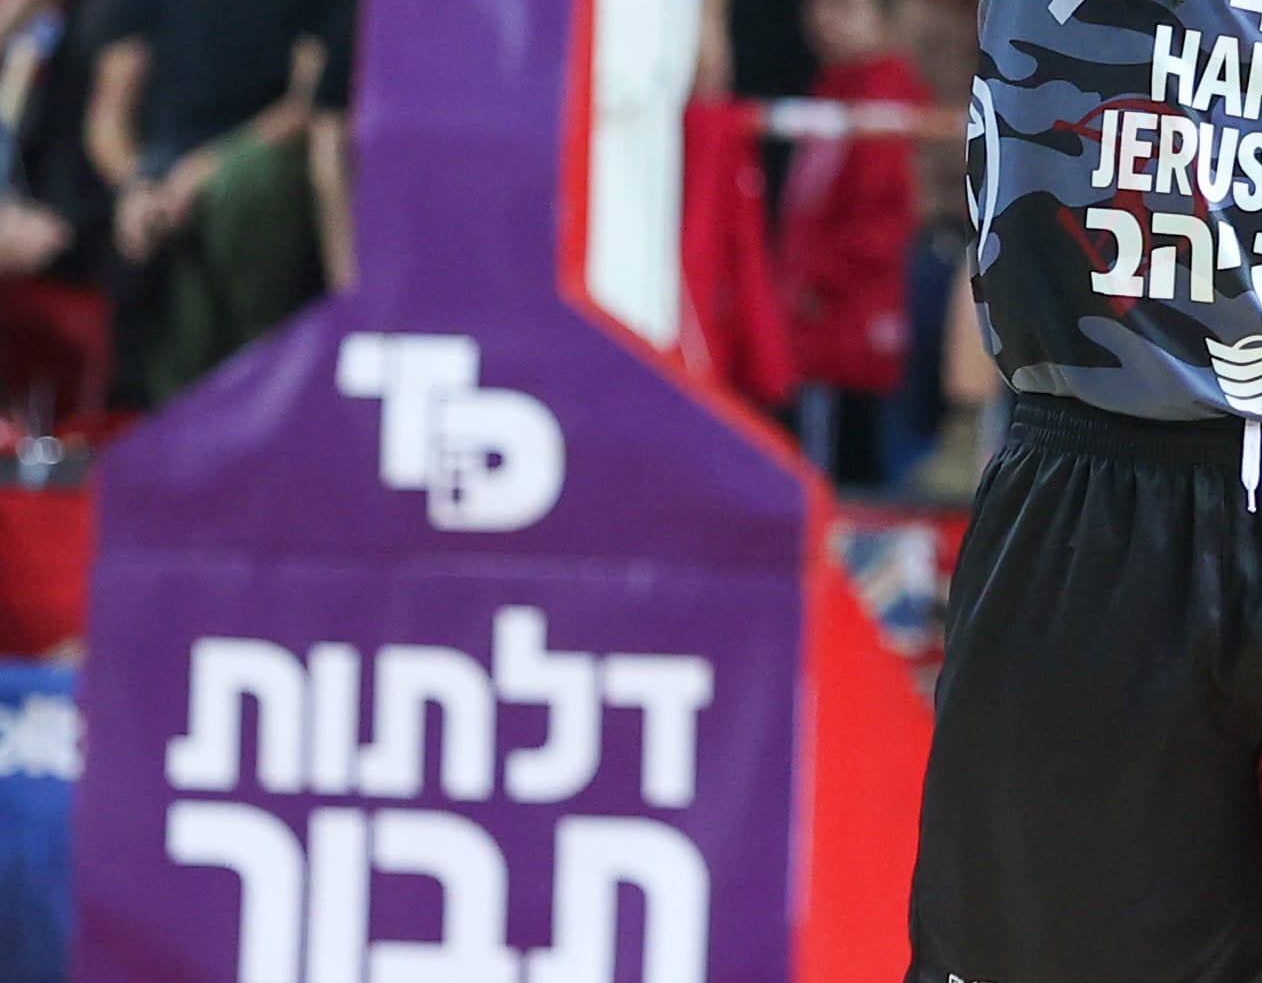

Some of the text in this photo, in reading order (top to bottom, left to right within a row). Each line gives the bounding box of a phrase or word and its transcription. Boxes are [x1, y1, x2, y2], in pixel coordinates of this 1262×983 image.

[1085, 207, 1241, 303] יהב
[165, 605, 714, 808] דלתות
[165, 799, 712, 983] תבור
